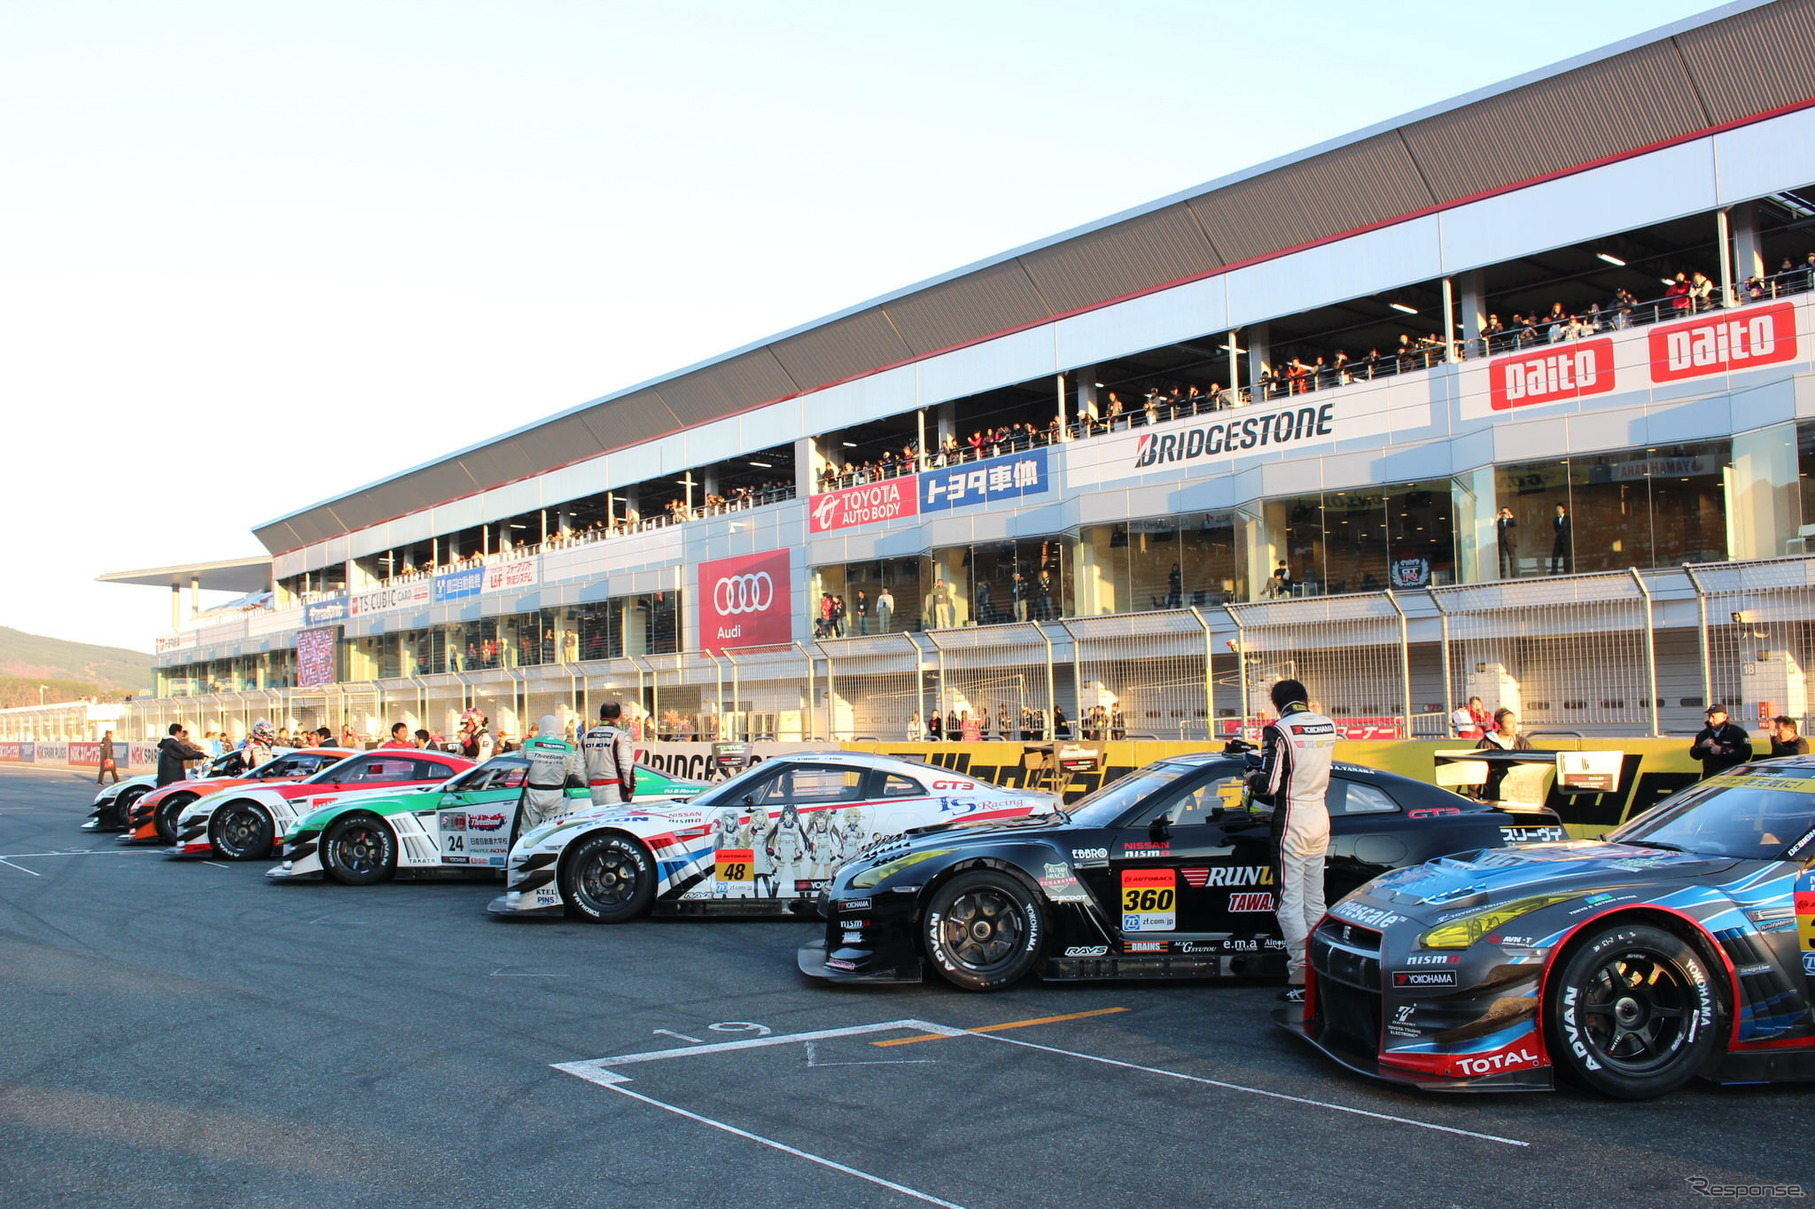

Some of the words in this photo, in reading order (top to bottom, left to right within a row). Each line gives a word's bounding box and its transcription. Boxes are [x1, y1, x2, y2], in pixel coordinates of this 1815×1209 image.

[1667, 314, 1775, 371] Daito
[1505, 349, 1596, 400] Daito
[1134, 402, 1335, 468] BRIDGESTONE
[927, 460, 1038, 504] トヨタ車体
[842, 483, 900, 510] TOYOTA
[842, 506, 870, 525] AUTO
[872, 501, 901, 521] BODY
[360, 595, 368, 612] TS
[371, 589, 396, 610] CUBIC
[398, 589, 411, 602] CARD
[717, 624, 741, 639] Audi
[1302, 725, 1334, 734] YOKOHAMA
[132, 746, 144, 765] NGK
[932, 779, 975, 791] GT3
[977, 799, 1024, 810] Racing
[1408, 807, 1460, 819] GT3
[377, 831, 390, 866] ADVAN
[448, 835, 464, 852] 24
[610, 840, 646, 872] ADVAN
[1072, 848, 1108, 859] EBBRO
[1125, 849, 1171, 858] nismo
[724, 863, 746, 881] 48
[846, 900, 869, 909] YOKOHAMA
[1123, 889, 1174, 911] 360
[1142, 916, 1174, 926] zf.com/jp
[1333, 898, 1398, 928] freescale
[840, 919, 871, 928] nismo
[1025, 902, 1038, 952] YOKOHAMA
[929, 912, 956, 971] ADVAN
[1131, 942, 1161, 951] BRAINS
[1223, 940, 1258, 949] e.m.a
[1065, 945, 1108, 957] RAYS
[1406, 955, 1461, 966] nismo
[1408, 974, 1453, 984] YOKOHAMA
[1685, 958, 1712, 1027] YOKOHAMA
[1564, 985, 1602, 1071] ADVAN
[1455, 1049, 1538, 1075] TOTAL
